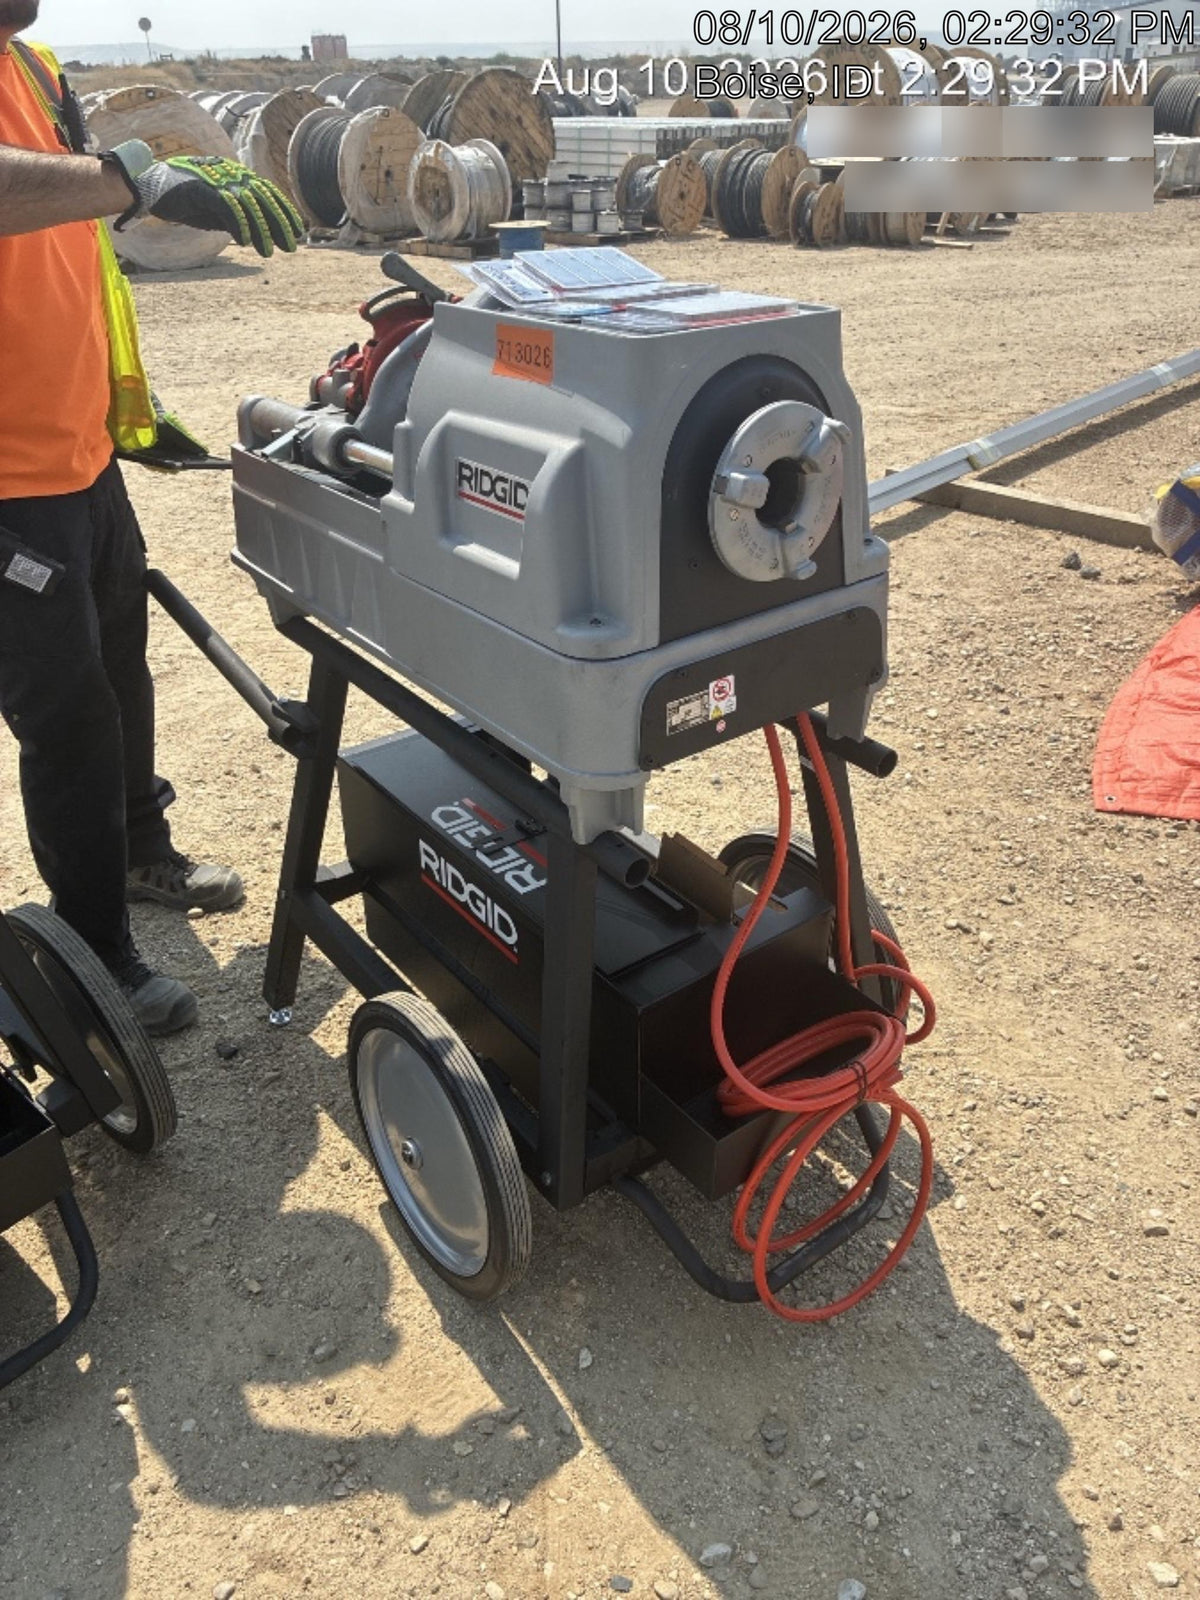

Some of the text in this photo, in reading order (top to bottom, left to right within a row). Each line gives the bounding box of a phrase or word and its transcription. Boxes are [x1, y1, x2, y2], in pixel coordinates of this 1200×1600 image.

[498, 339, 552, 368] 713026
[458, 461, 529, 511] RIDGID
[419, 839, 518, 945] RIDGID
